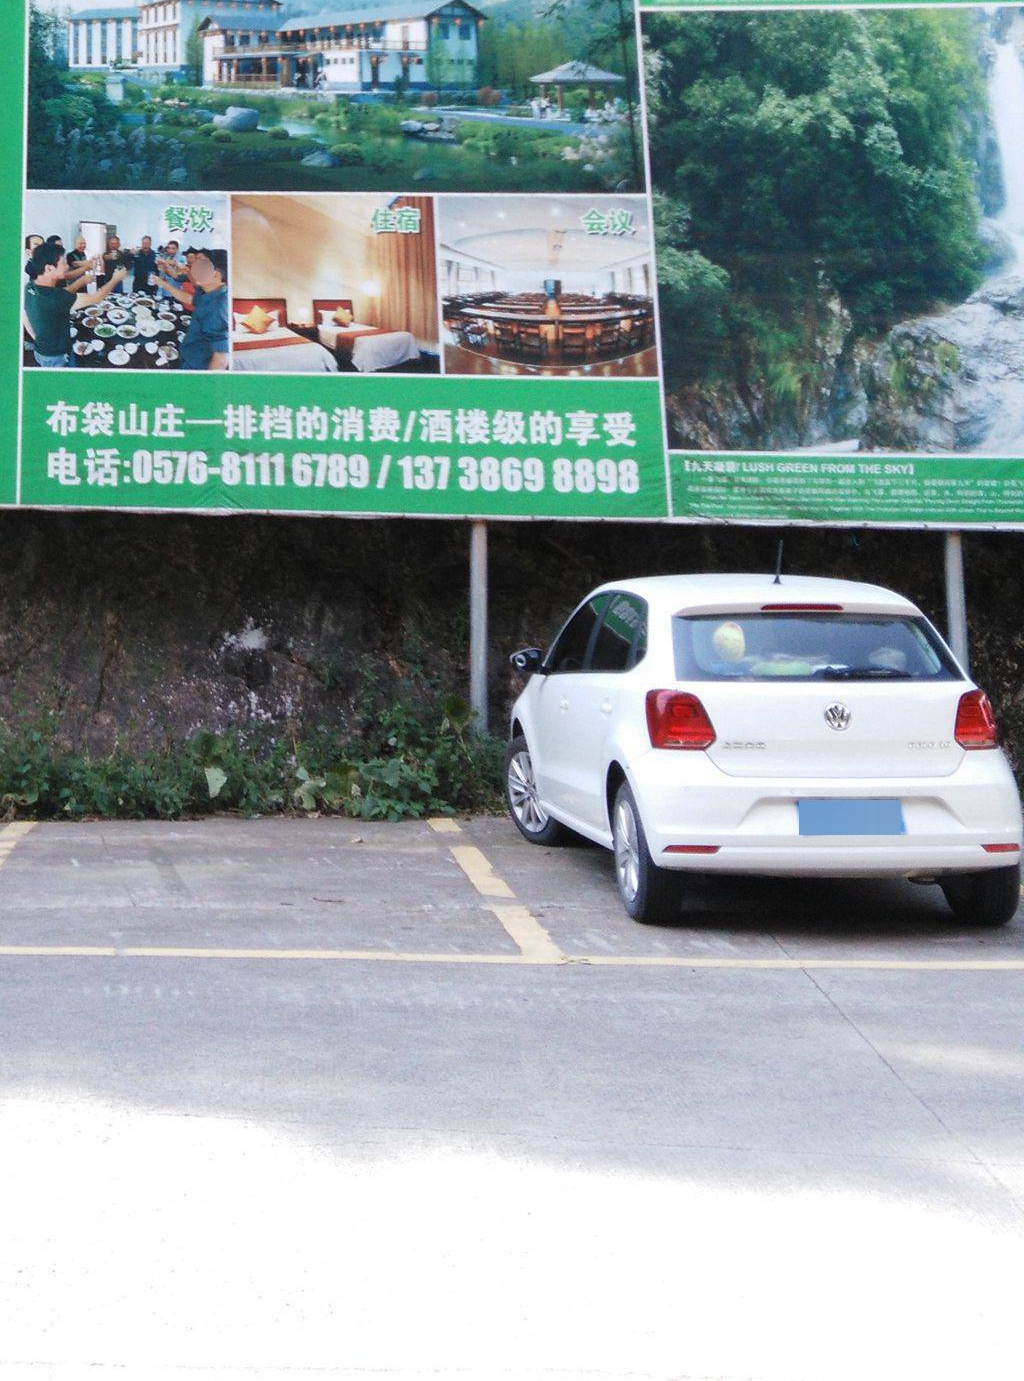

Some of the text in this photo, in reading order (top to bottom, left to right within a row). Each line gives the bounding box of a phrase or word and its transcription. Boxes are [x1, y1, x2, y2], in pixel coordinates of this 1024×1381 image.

[163, 205, 215, 233] 餐饮
[370, 206, 421, 234] 住宿
[581, 207, 635, 236] 会议
[291, 452, 370, 488] 6789
[397, 455, 451, 490] 137
[457, 456, 545, 492] 3869
[552, 458, 640, 494] 8898
[741, 462, 774, 473] LUSH
[776, 463, 818, 473] GREEN
[820, 463, 855, 474] FROM
[858, 464, 882, 474] THE
